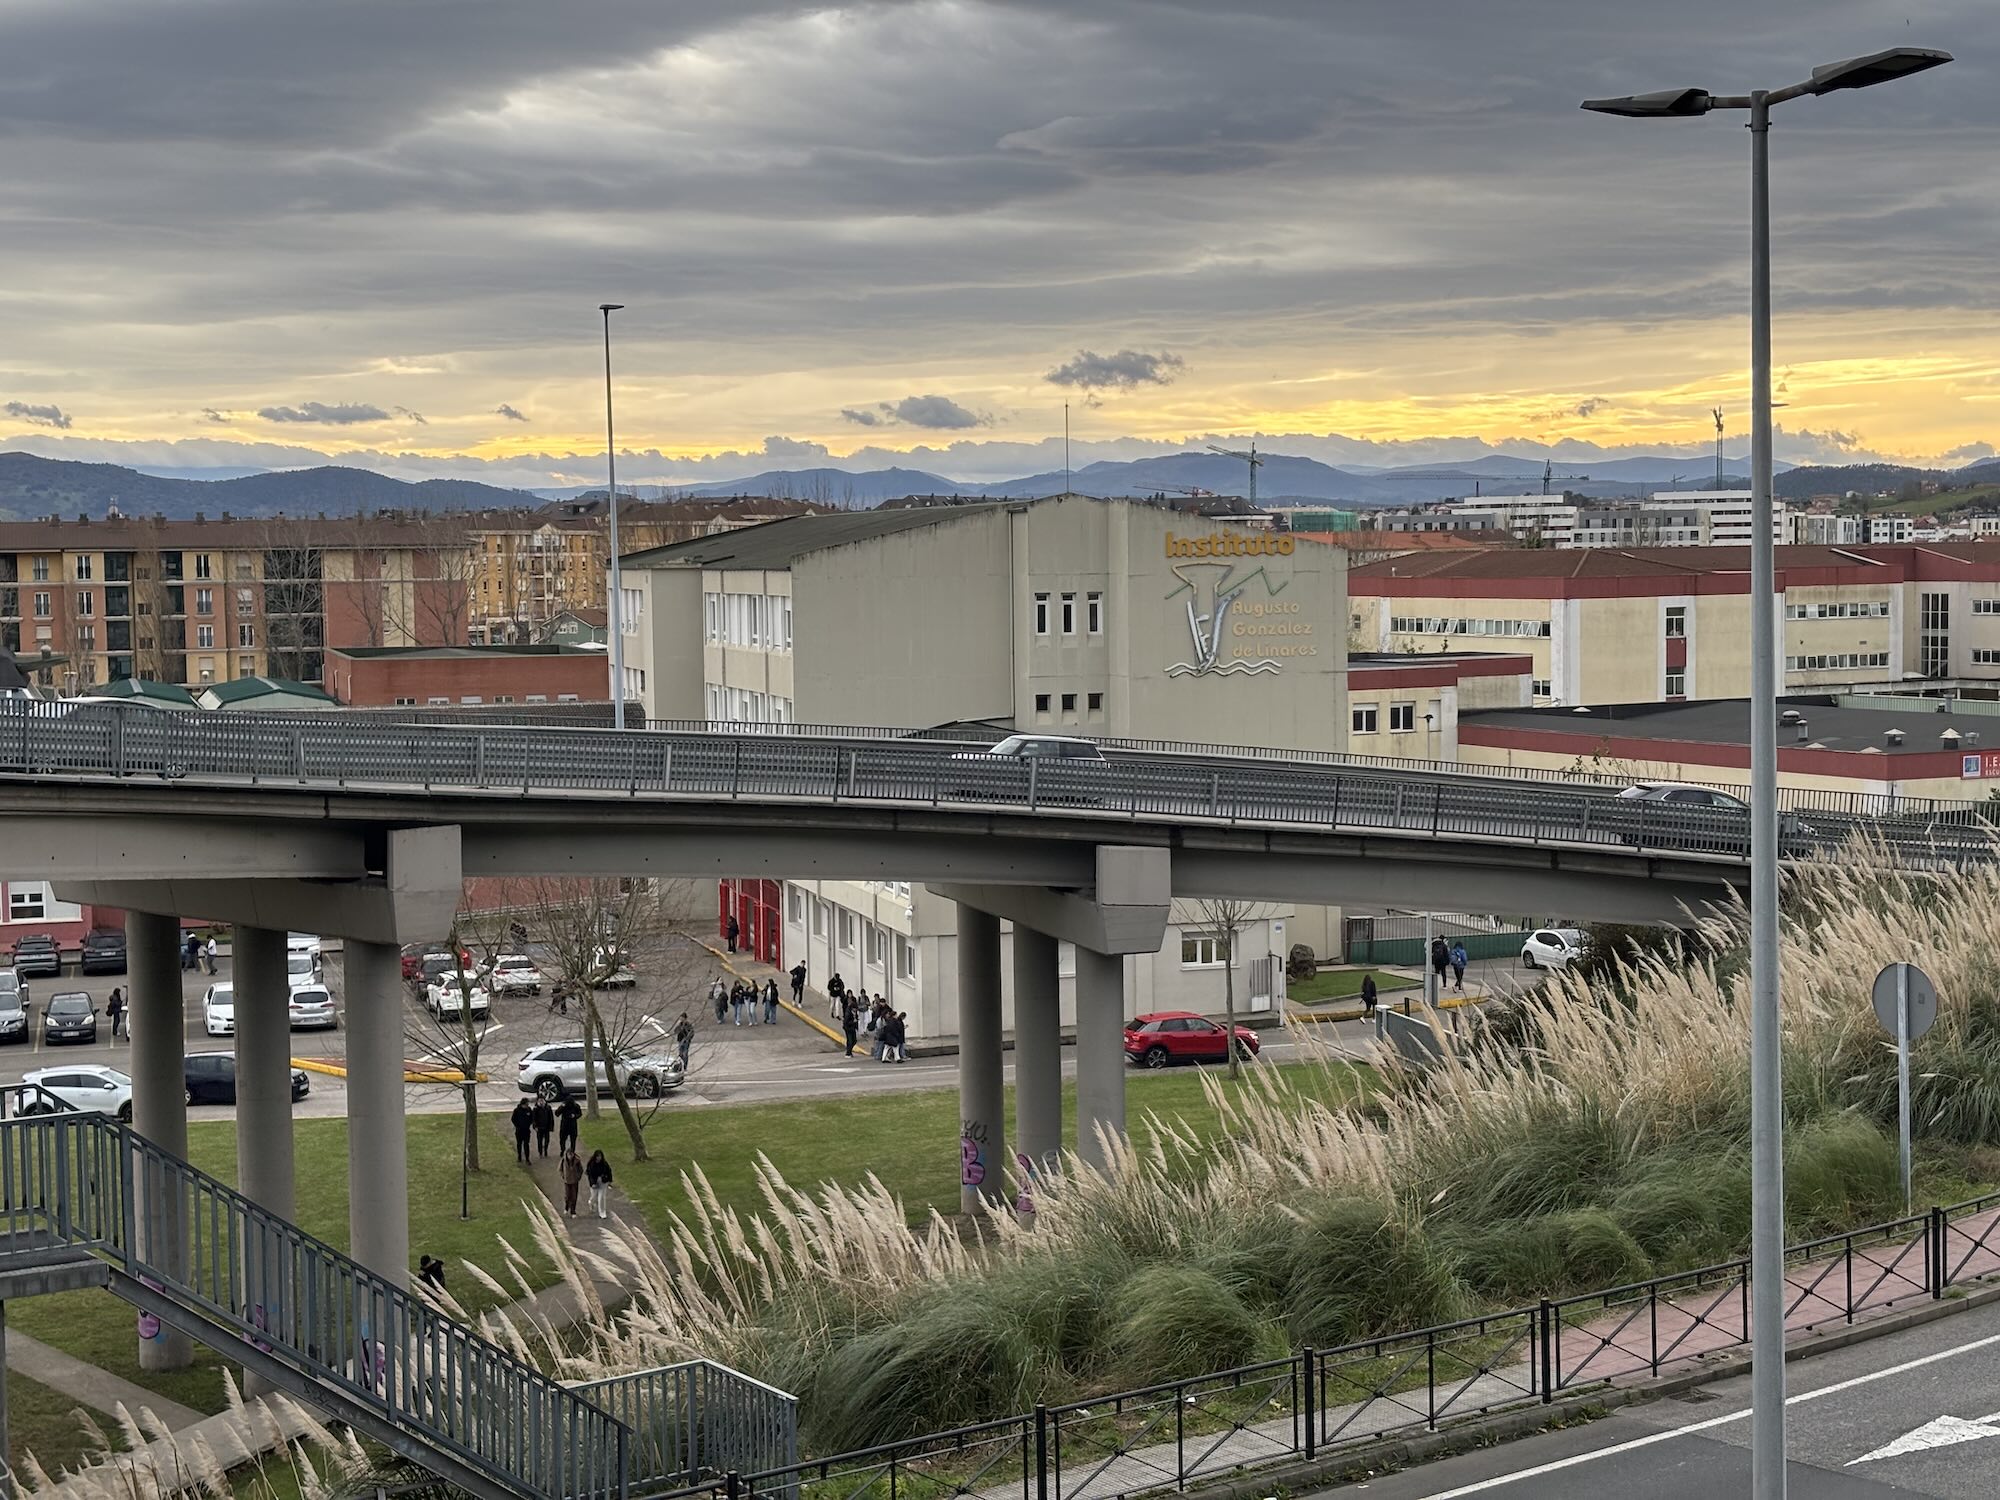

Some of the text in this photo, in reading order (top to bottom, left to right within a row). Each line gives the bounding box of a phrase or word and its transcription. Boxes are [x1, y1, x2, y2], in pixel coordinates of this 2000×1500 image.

[1165, 528, 1295, 558] Instituto
[1231, 601, 1300, 618] Augusto
[1232, 643, 1317, 658] de Linares
